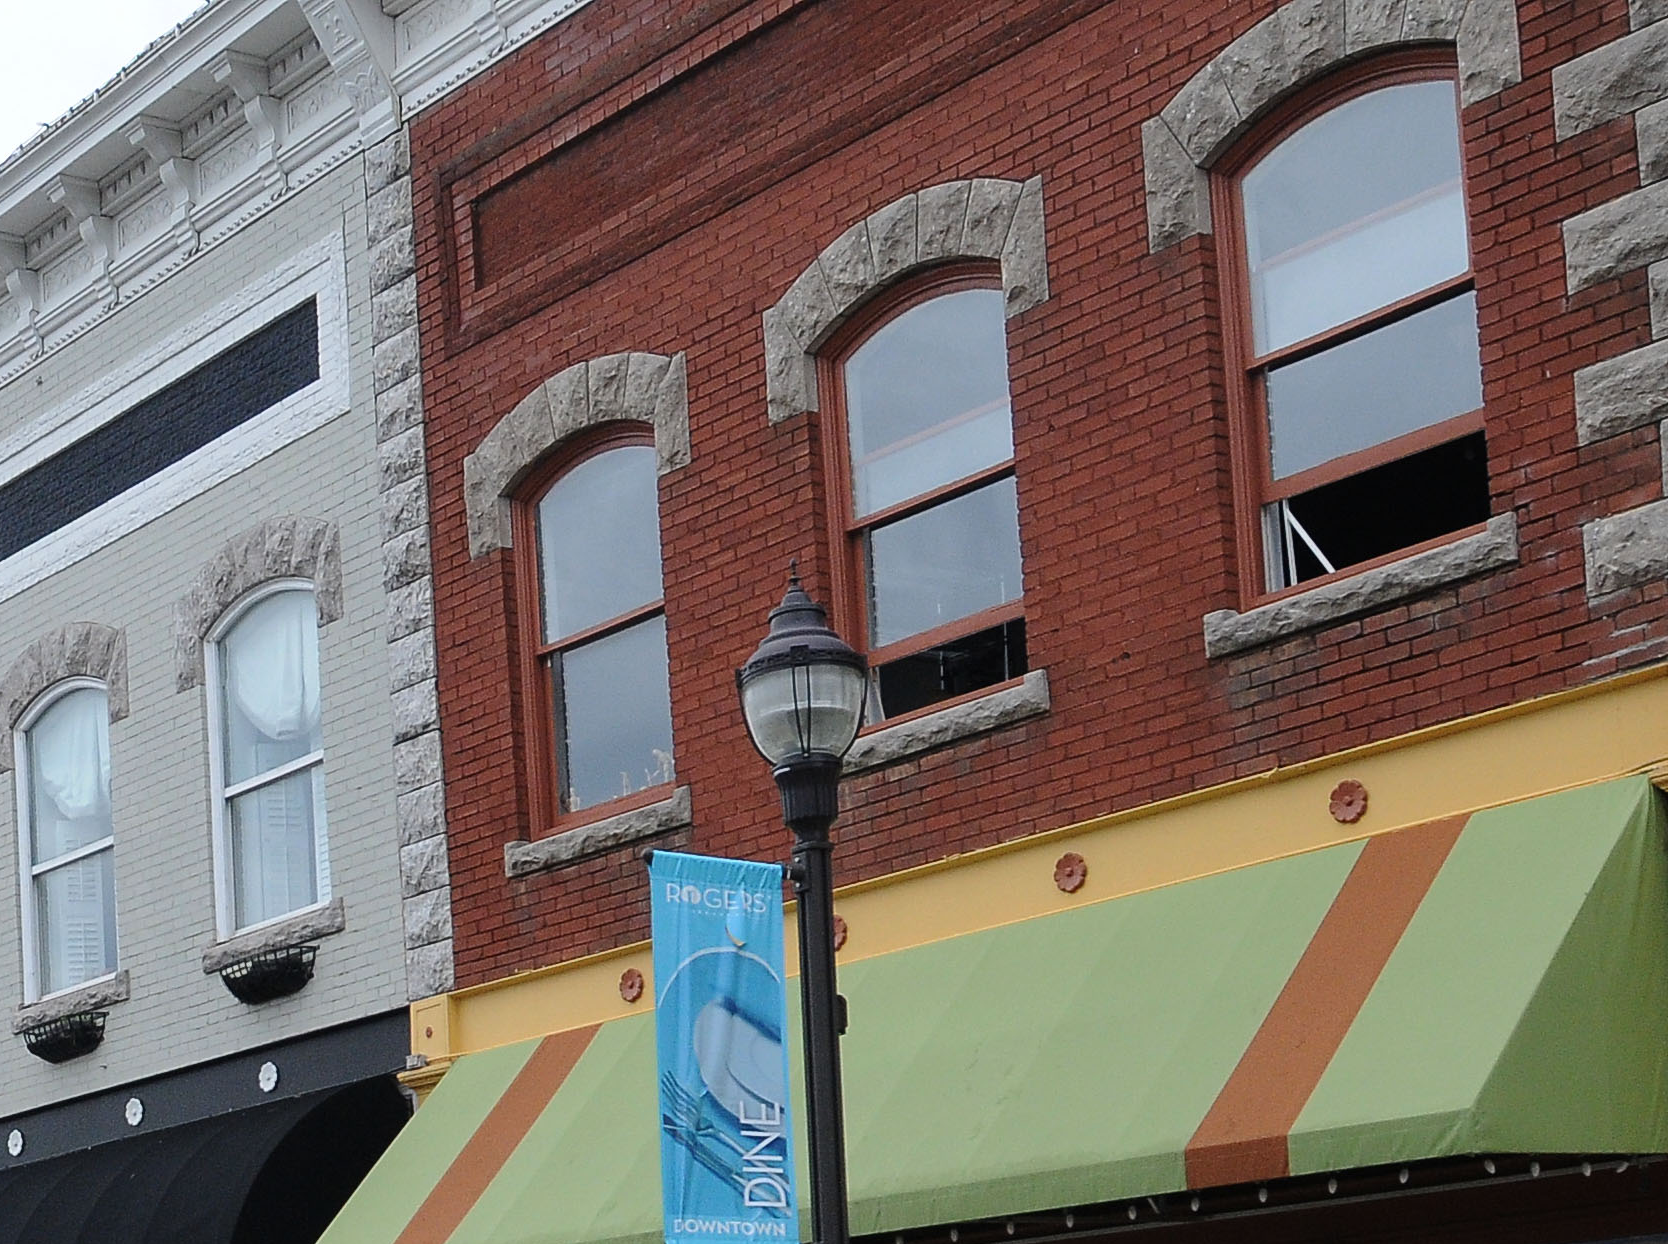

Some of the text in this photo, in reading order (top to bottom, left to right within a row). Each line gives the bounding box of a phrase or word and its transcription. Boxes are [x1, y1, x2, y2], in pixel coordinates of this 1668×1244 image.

[666, 882, 767, 913] ROGERS
[740, 1101, 787, 1207] DINE
[673, 1218, 786, 1237] DOWNTOWN
